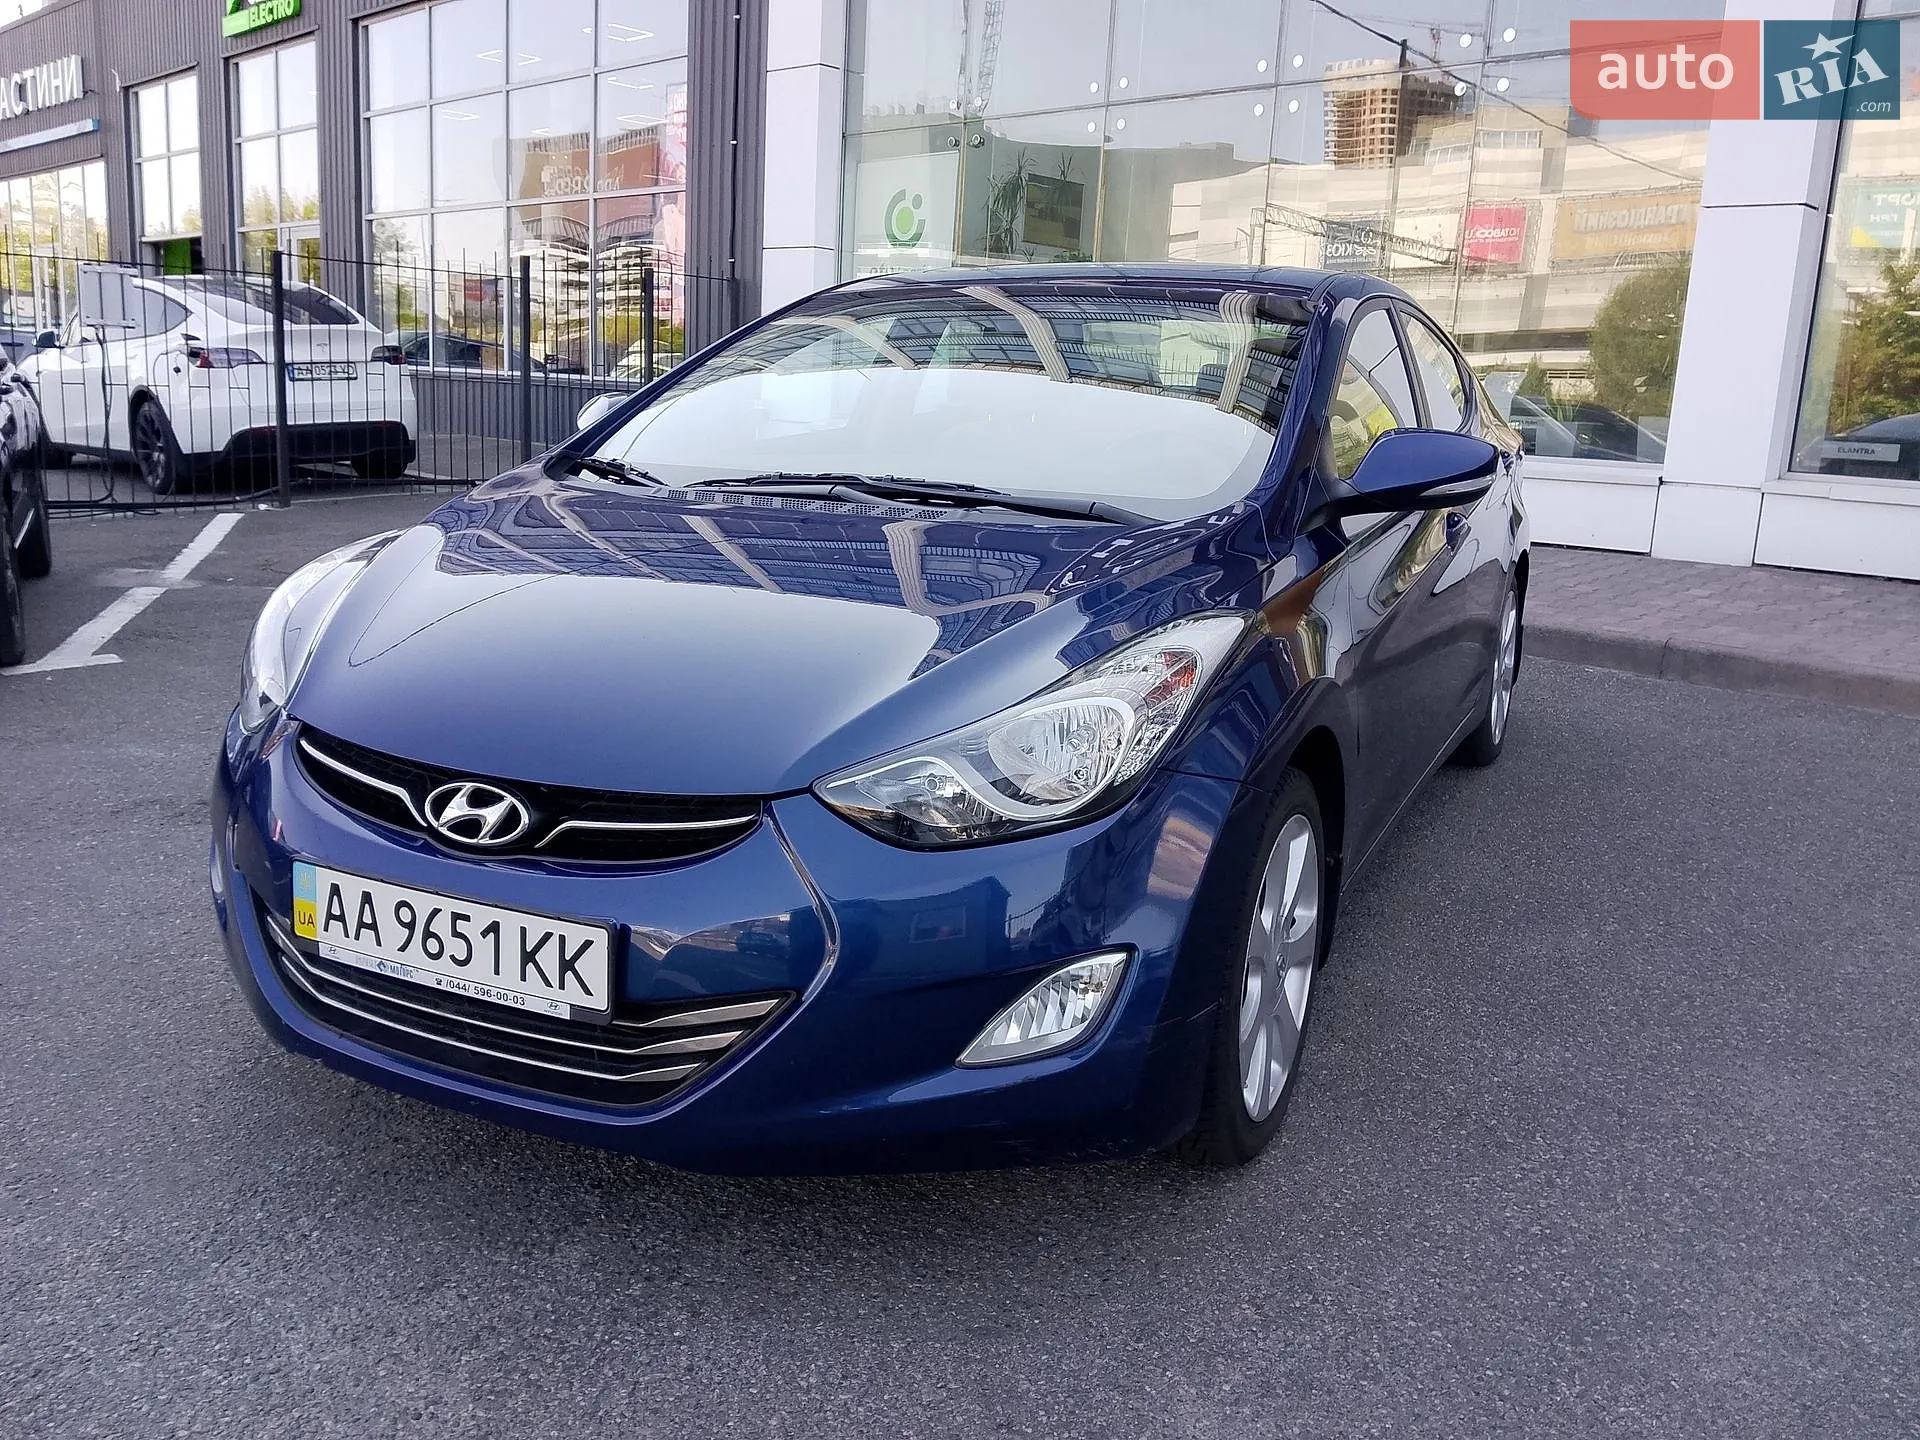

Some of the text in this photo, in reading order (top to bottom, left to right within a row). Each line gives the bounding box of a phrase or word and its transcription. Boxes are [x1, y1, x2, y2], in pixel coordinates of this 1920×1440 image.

[249, 0, 295, 28] ELECTRO
[1837, 447, 1875, 455] ELANTRA
[297, 911, 315, 927] UA
[323, 882, 594, 997] AA 9651 KK
[445, 979, 526, 1007] /044/ 596-00-03
